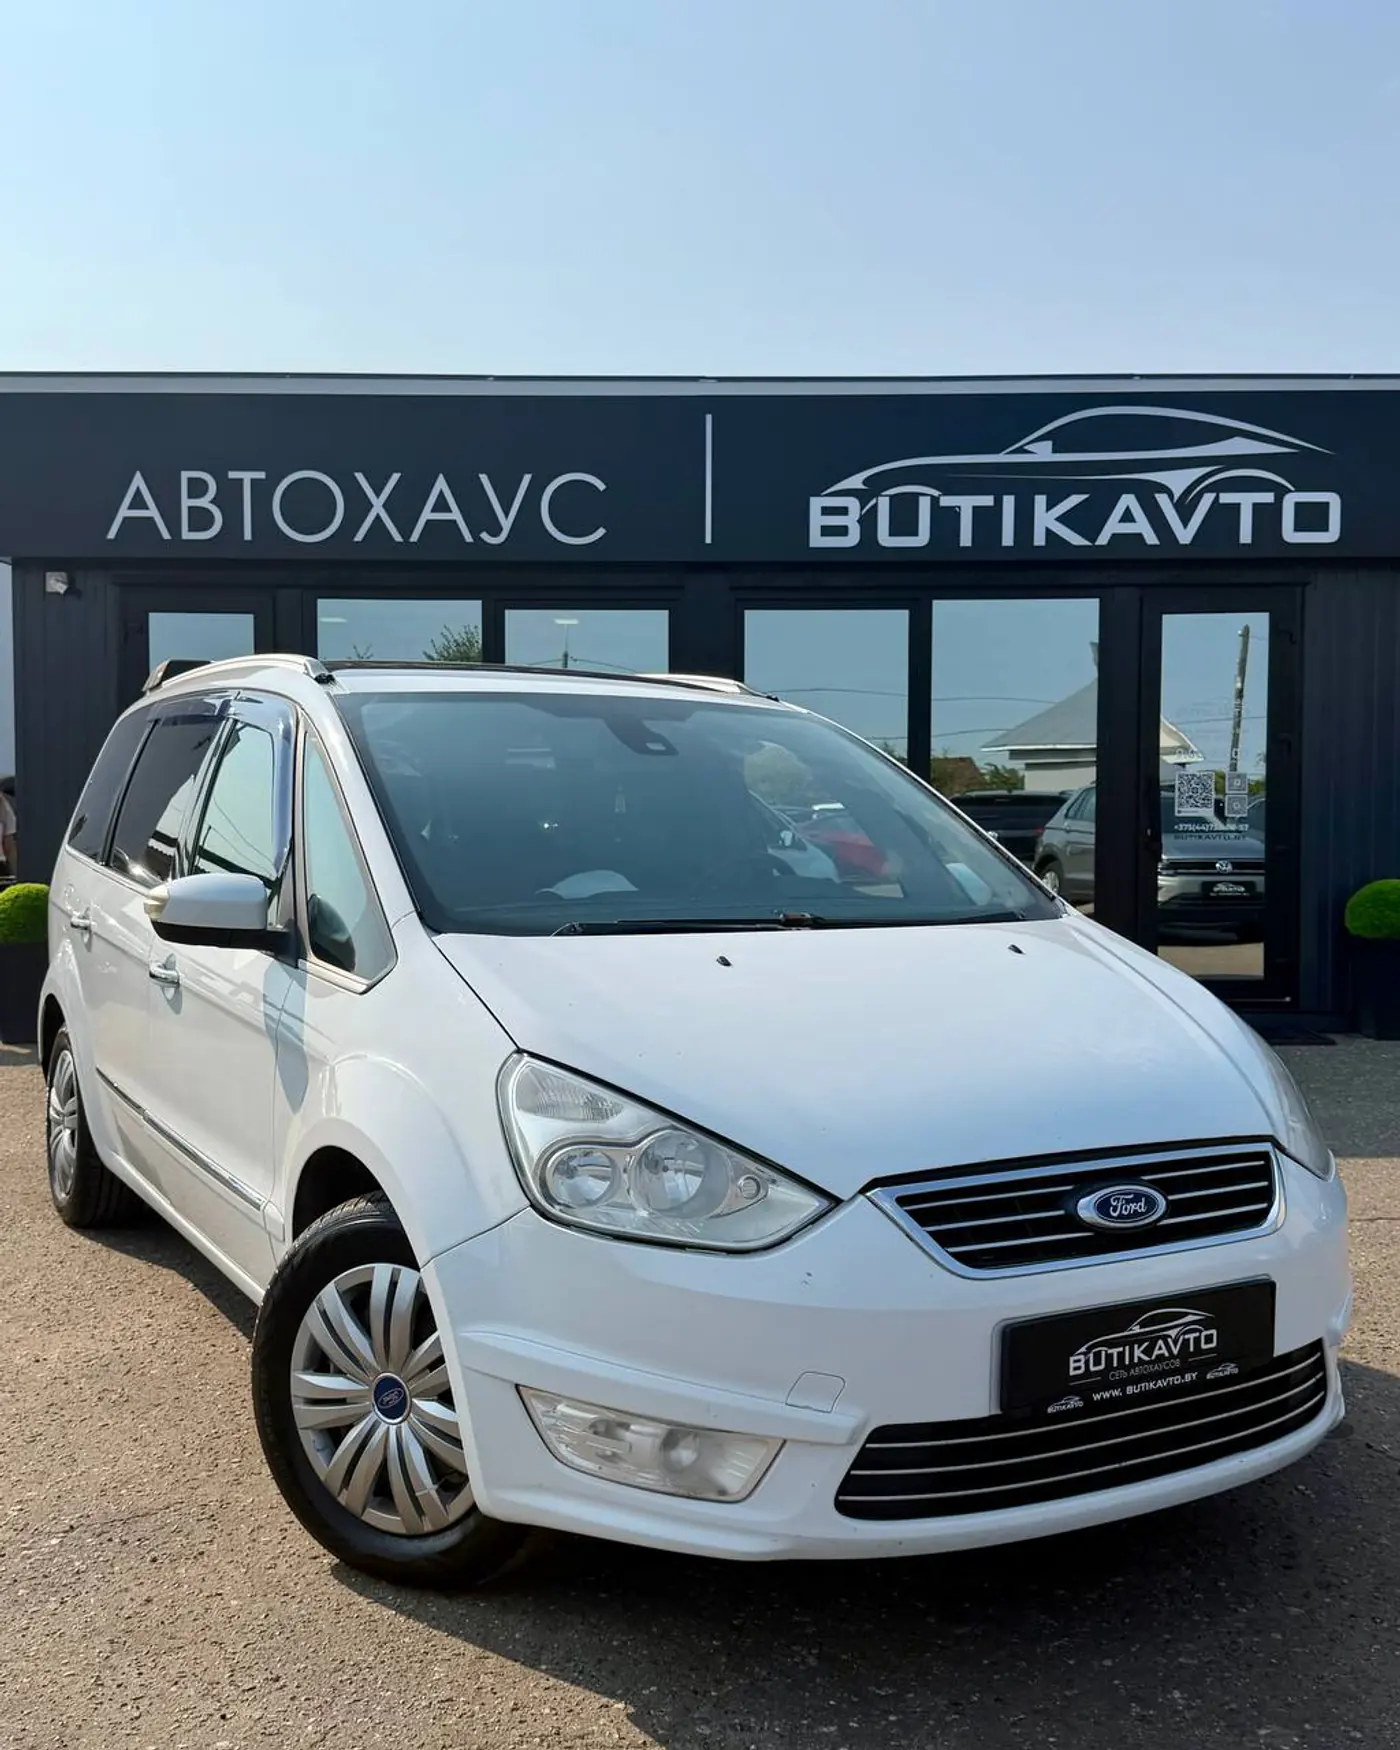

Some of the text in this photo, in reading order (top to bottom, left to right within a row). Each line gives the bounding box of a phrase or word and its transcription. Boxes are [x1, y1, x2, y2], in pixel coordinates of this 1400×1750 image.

[106, 470, 608, 545] АВТОХАУС
[808, 491, 1342, 548] BUTIKAVTO
[1109, 1193, 1148, 1217] Ford
[1069, 1328, 1218, 1377] BUTIKAVTO
[1129, 1358, 1181, 1377] АВТОХАУСОВ
[1126, 1372, 1198, 1395] BUTIKAVTO.BY
